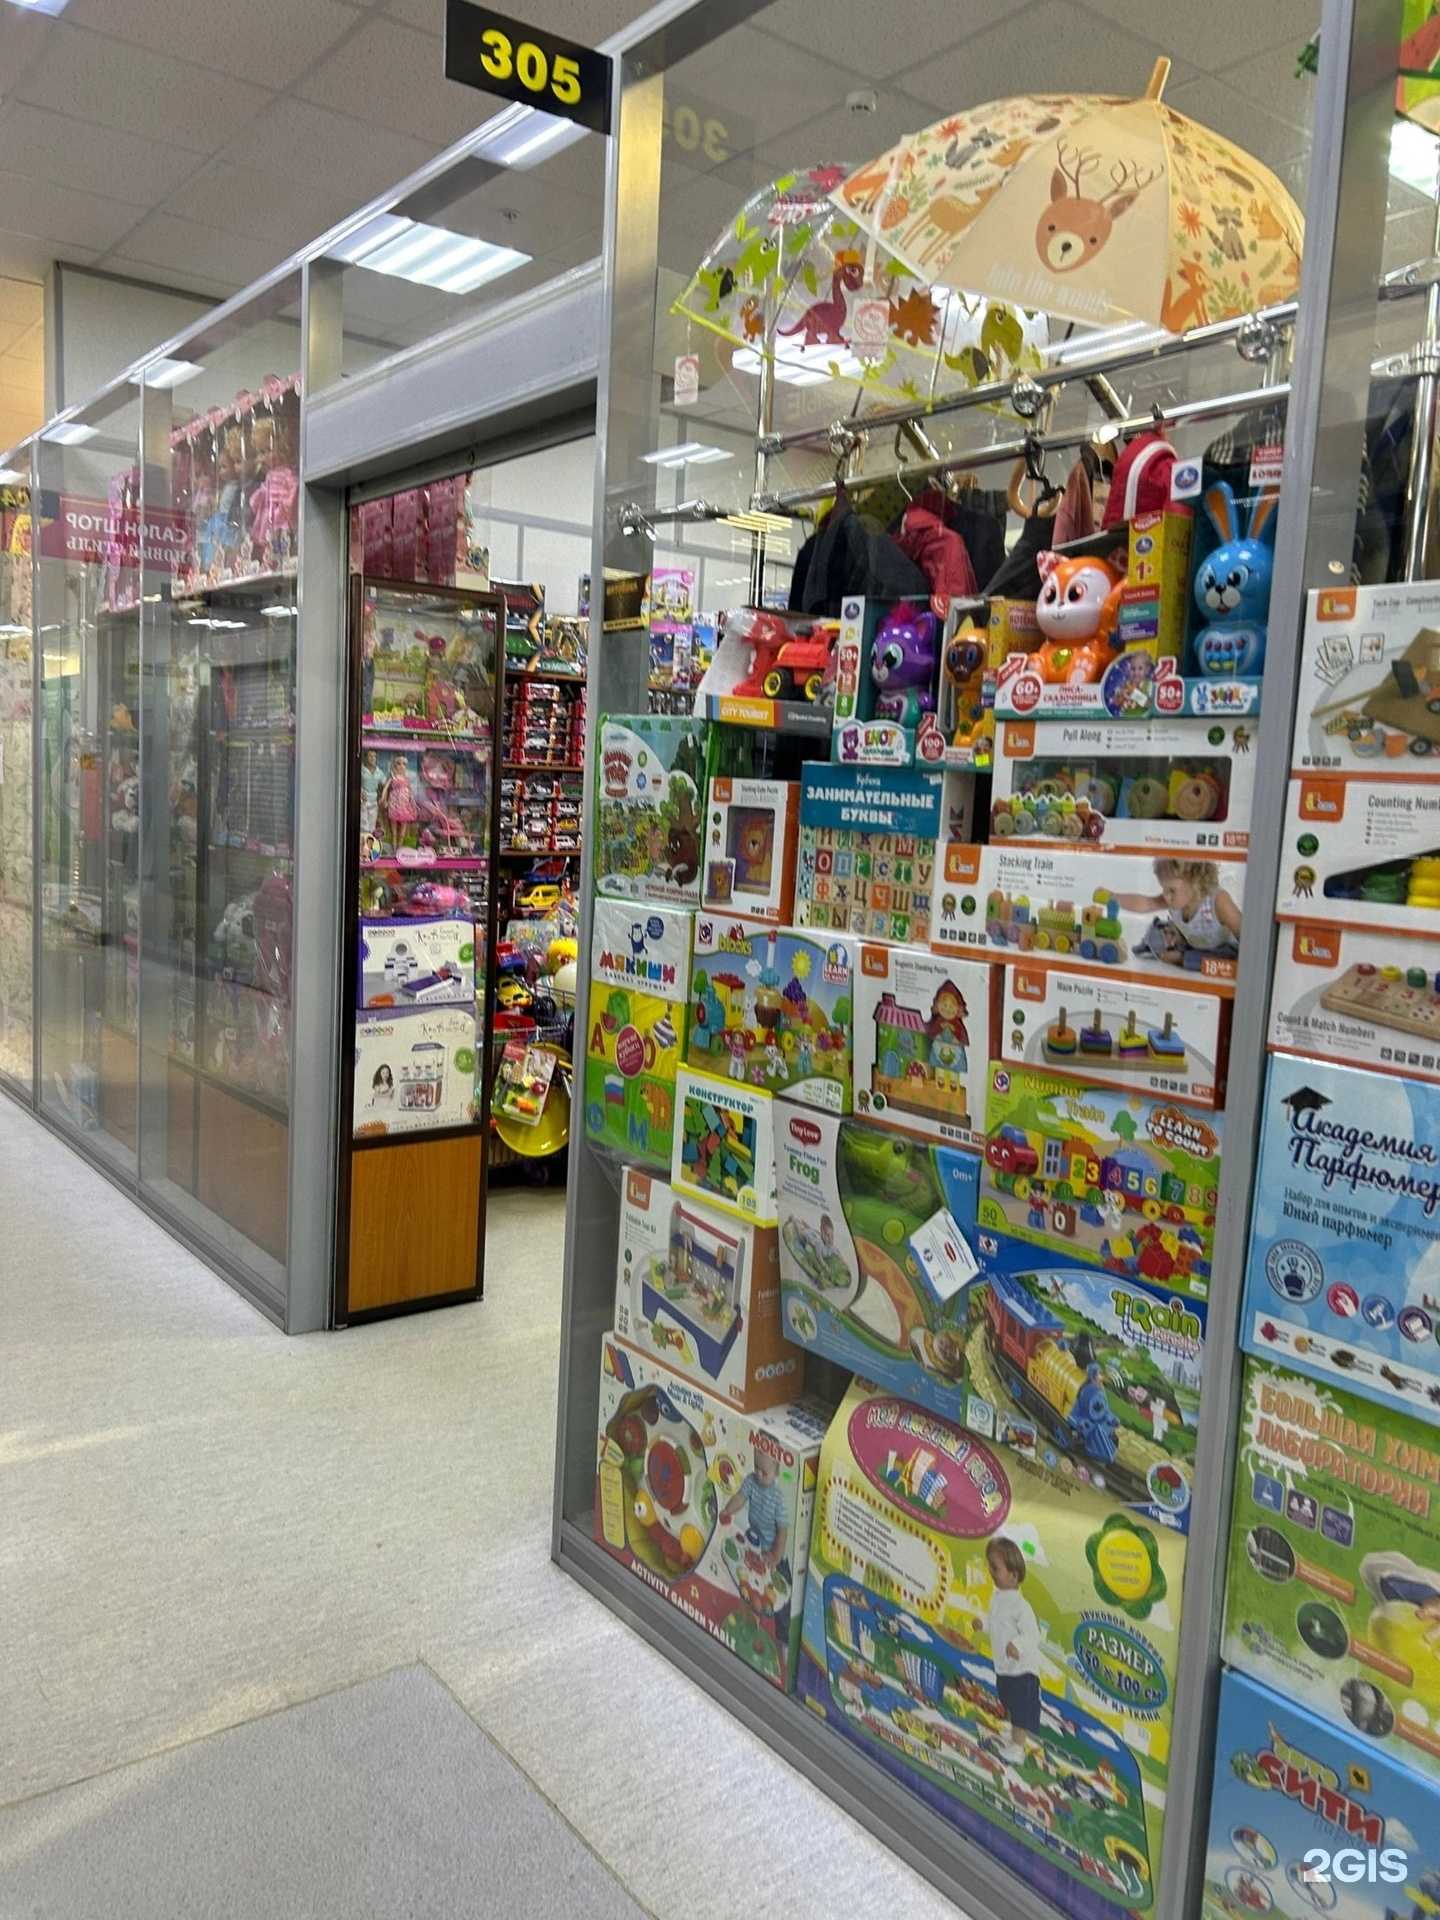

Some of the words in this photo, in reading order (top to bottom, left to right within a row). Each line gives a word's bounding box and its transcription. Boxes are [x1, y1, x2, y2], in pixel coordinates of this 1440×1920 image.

[480, 28, 582, 105] 305
[806, 785, 935, 809] ЗАНИМАТЕЛЬНЫЕ
[1367, 794, 1413, 812] Counting
[840, 807, 893, 826] БУКВЫ
[998, 853, 1032, 872] Stacking
[1034, 857, 1054, 871] Train
[600, 949, 675, 984] МЯКИШИ
[1276, 1011, 1301, 1027] Count
[1311, 1017, 1337, 1032] Match
[1338, 1023, 1377, 1041] Numbers
[688, 1084, 755, 1114] КОНСТРУКТОР
[1023, 1074, 1083, 1100] Number
[790, 1120, 804, 1136] Tiny
[804, 1126, 819, 1141] Love
[1146, 1121, 1163, 1136] TO
[1165, 1130, 1209, 1157] COUNT
[1159, 1114, 1203, 1140] LEARN
[1291, 1108, 1438, 1164] Академия
[788, 1154, 821, 1185] Frog
[1087, 1161, 1099, 1183] 3
[1126, 1170, 1140, 1192] 5
[1144, 1177, 1158, 1195] 6
[1284, 1187, 1313, 1208] Набор
[1054, 1211, 1066, 1230] 0
[1283, 1201, 1319, 1226] Юный
[1322, 1216, 1393, 1250] парфюмер
[1259, 1382, 1377, 1458] БОЛЬШАЯ
[748, 1428, 796, 1468] MOLTO
[1256, 1417, 1432, 1520] ЛАБОРАТОРИЯ
[630, 1558, 670, 1599] ACTIVITY
[671, 1590, 706, 1631] GARDEN
[708, 1620, 737, 1651] TABLE
[1088, 1627, 1154, 1678] РАЗМЕР
[1116, 1669, 1141, 1695] 100
